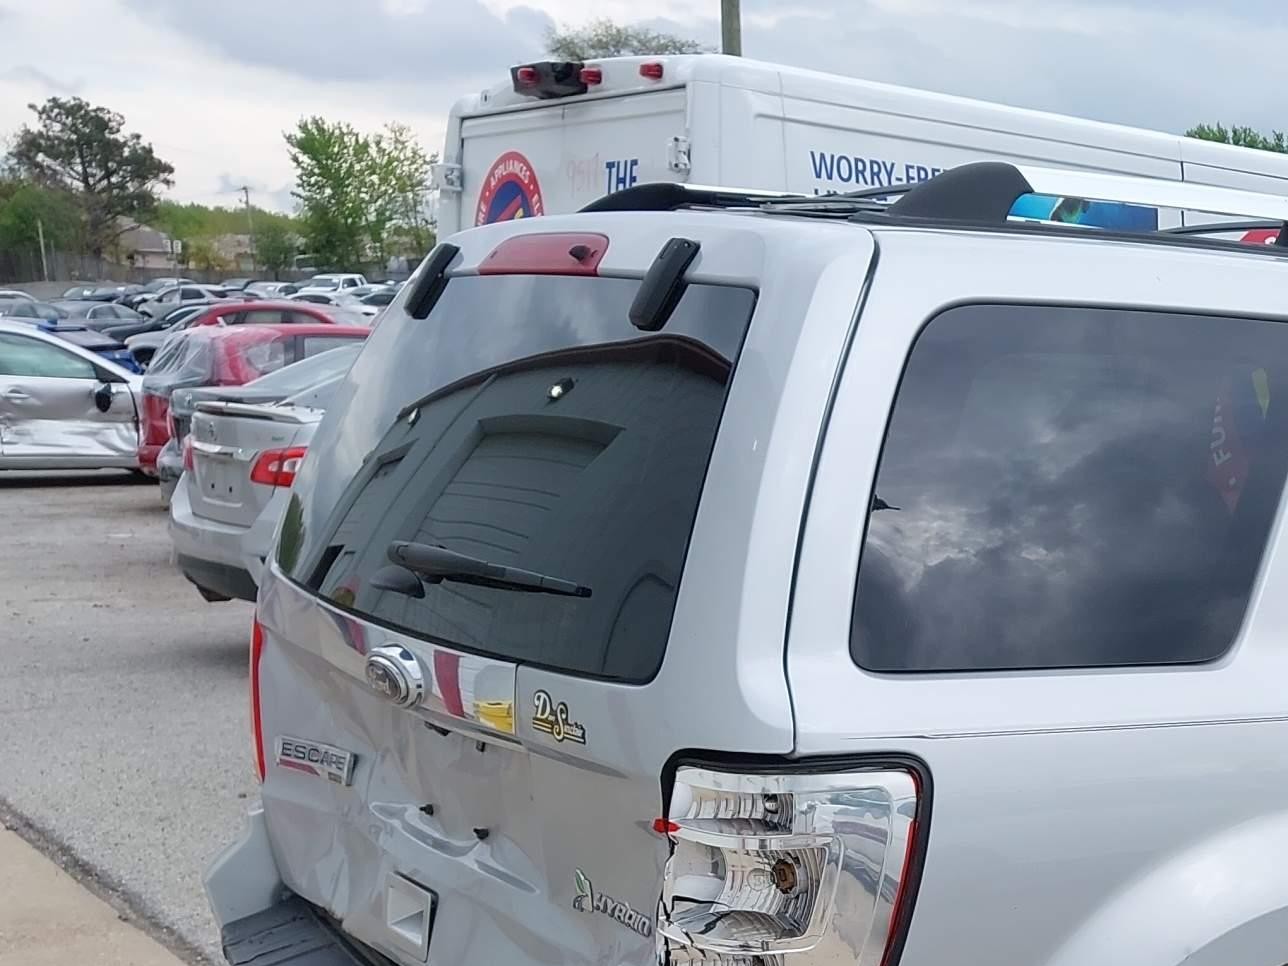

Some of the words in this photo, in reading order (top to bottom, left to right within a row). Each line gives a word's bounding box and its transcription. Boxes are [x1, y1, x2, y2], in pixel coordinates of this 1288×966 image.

[489, 159, 531, 188] APPLIANCES
[605, 158, 639, 197] THE
[809, 150, 947, 188] WORRY-FRE
[281, 741, 347, 772] ESCAPE
